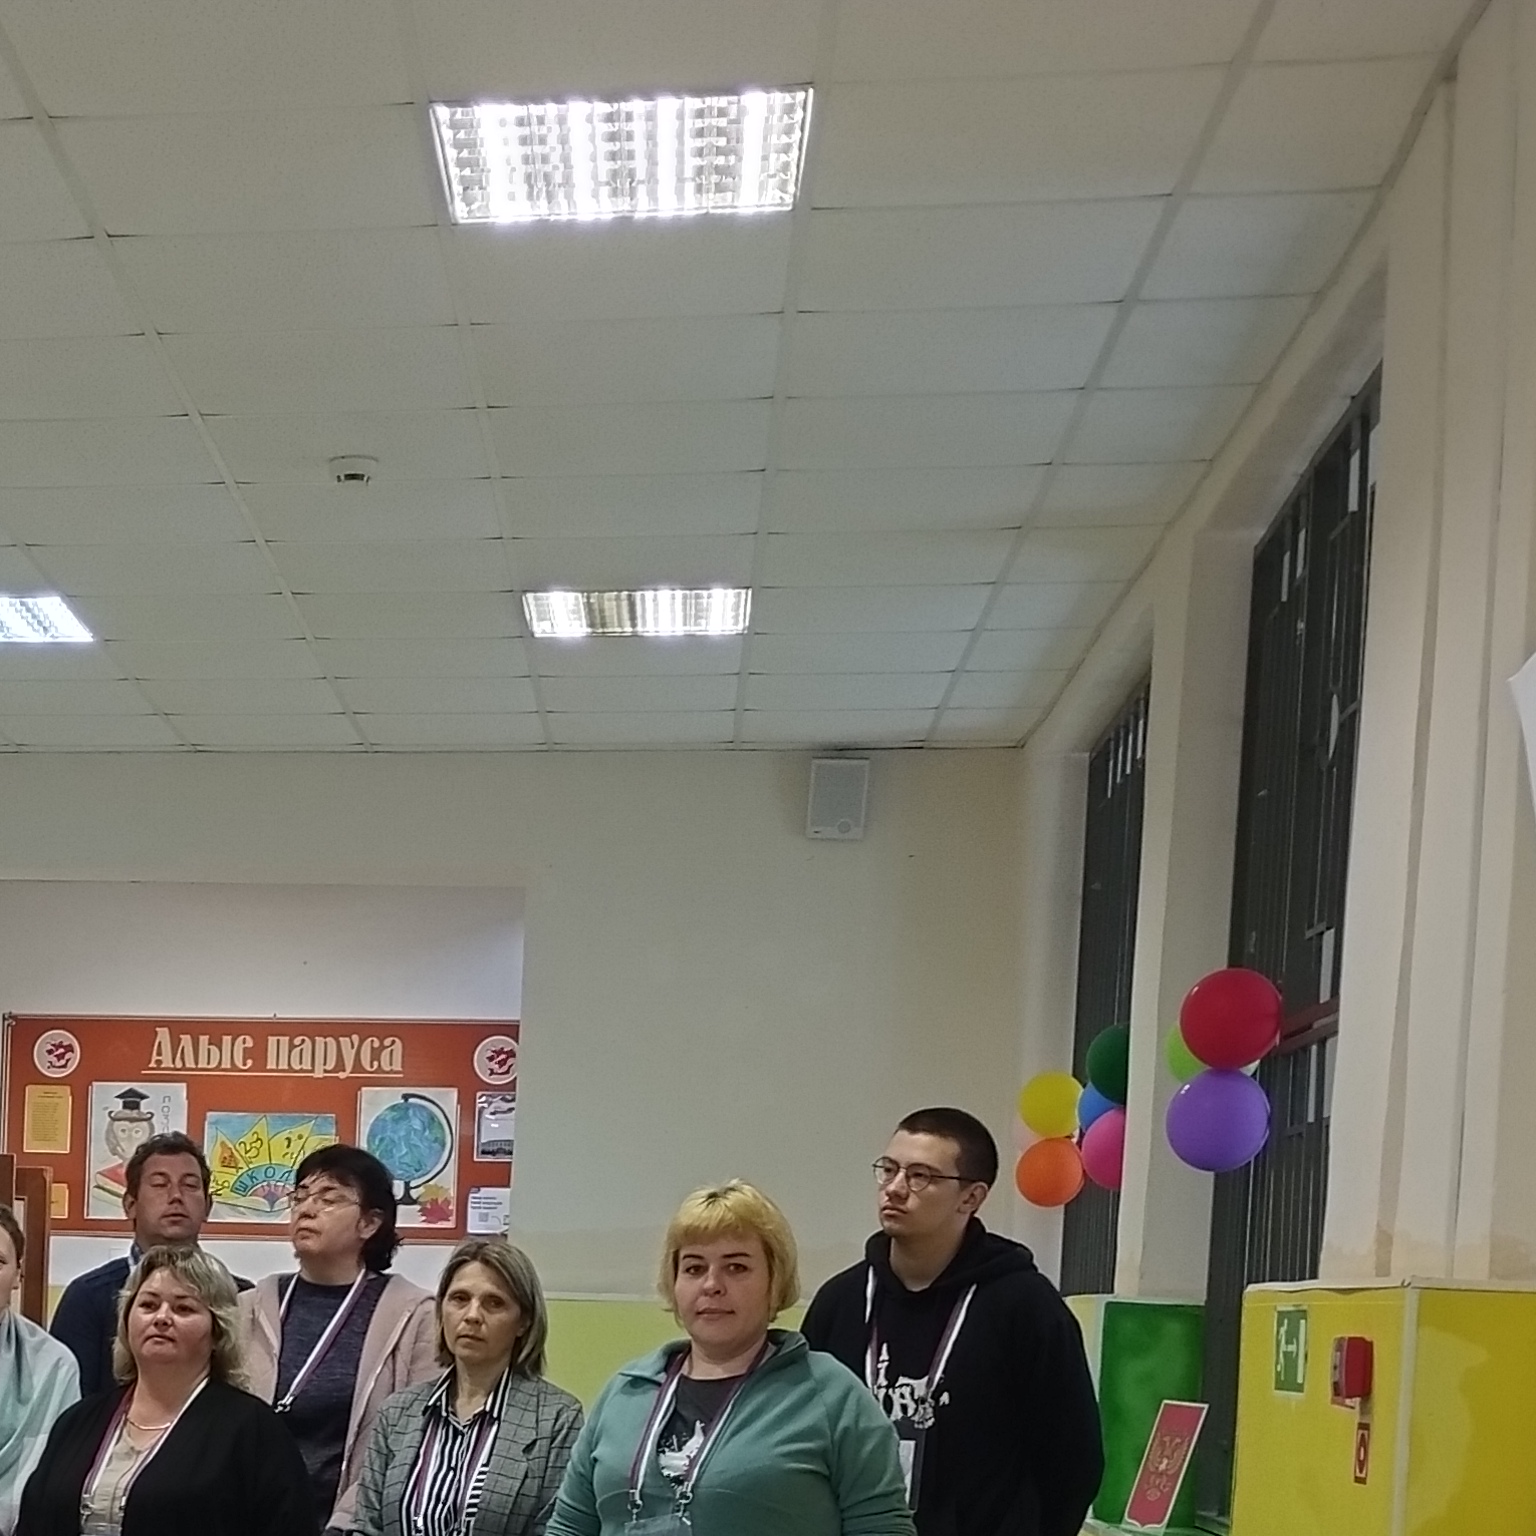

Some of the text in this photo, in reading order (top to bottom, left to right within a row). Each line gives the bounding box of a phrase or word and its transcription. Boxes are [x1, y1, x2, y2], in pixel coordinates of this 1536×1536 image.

[148, 1027, 404, 1079] Алые паруса
[234, 1166, 293, 1194] ШКОЛ
